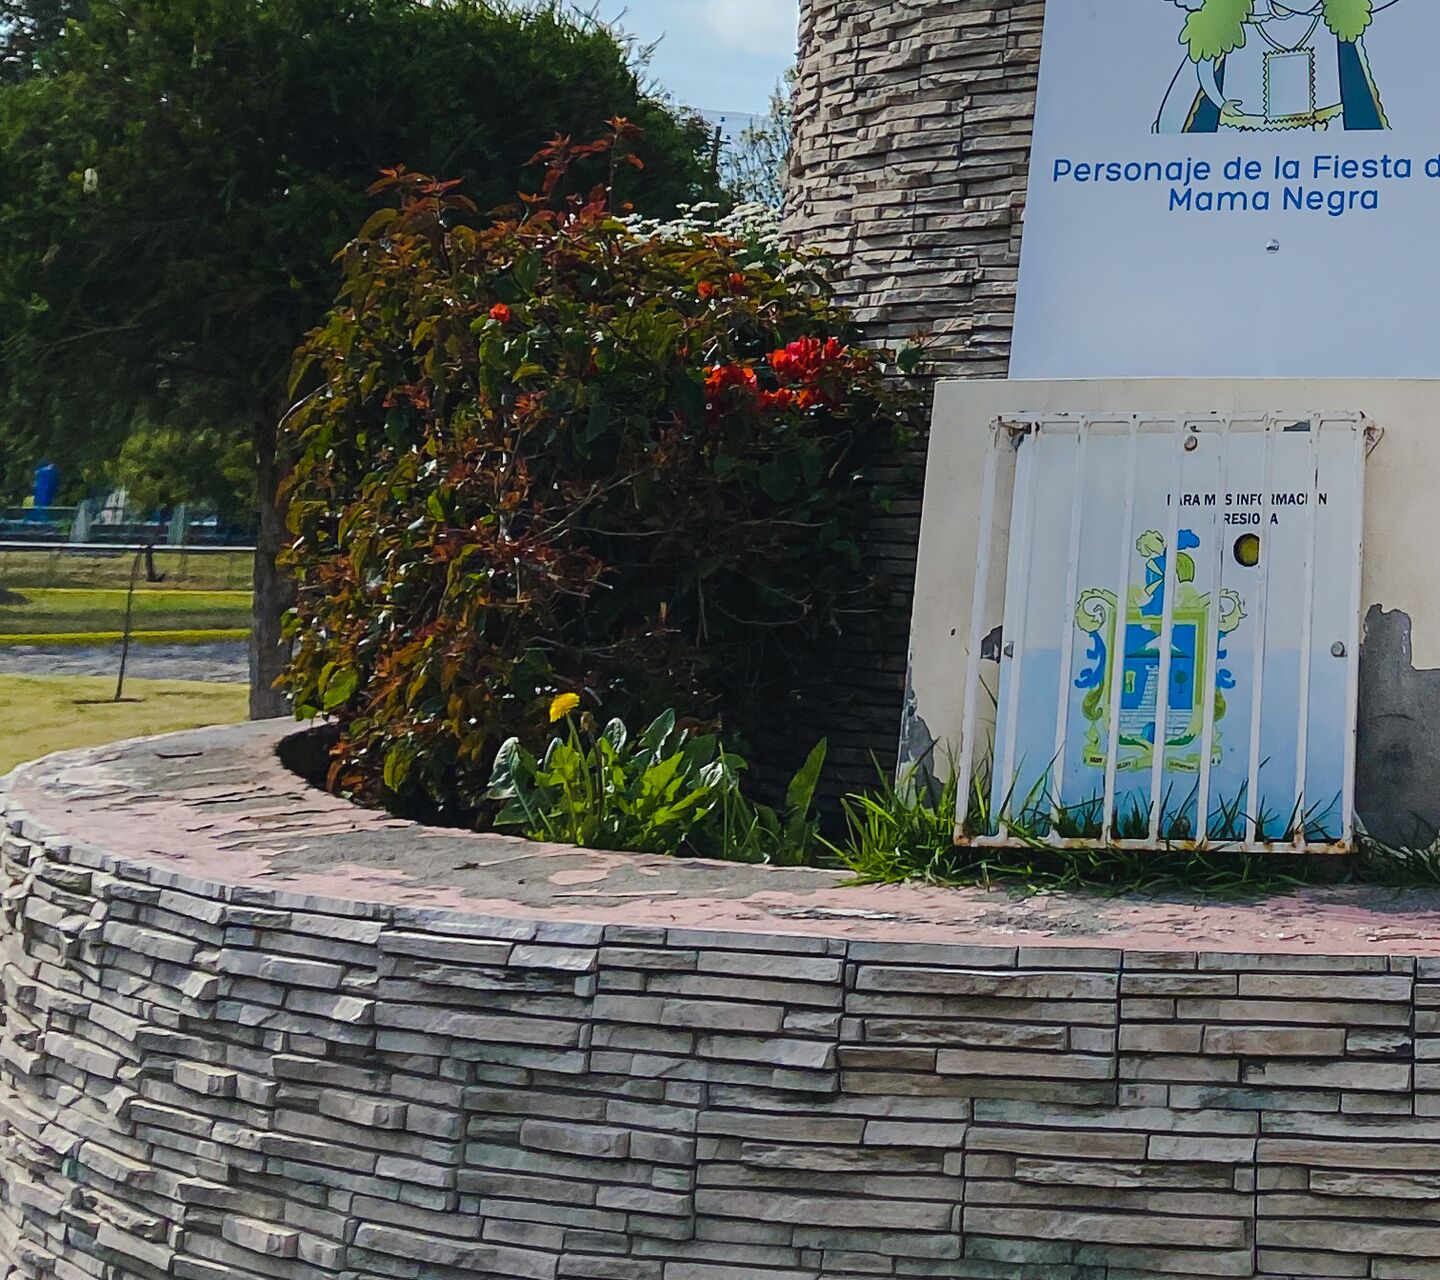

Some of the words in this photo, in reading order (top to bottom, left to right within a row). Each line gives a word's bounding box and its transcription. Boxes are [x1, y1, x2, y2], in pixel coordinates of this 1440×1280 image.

[1053, 157, 1211, 187] Personaje
[1223, 156, 1262, 181] de
[1274, 155, 1300, 180] la
[1313, 154, 1412, 179] Fiesta
[1168, 187, 1270, 212] Mama
[1283, 186, 1378, 216] Negra
[1204, 493, 1233, 506] MS
[1213, 512, 1279, 525] RESIOA
